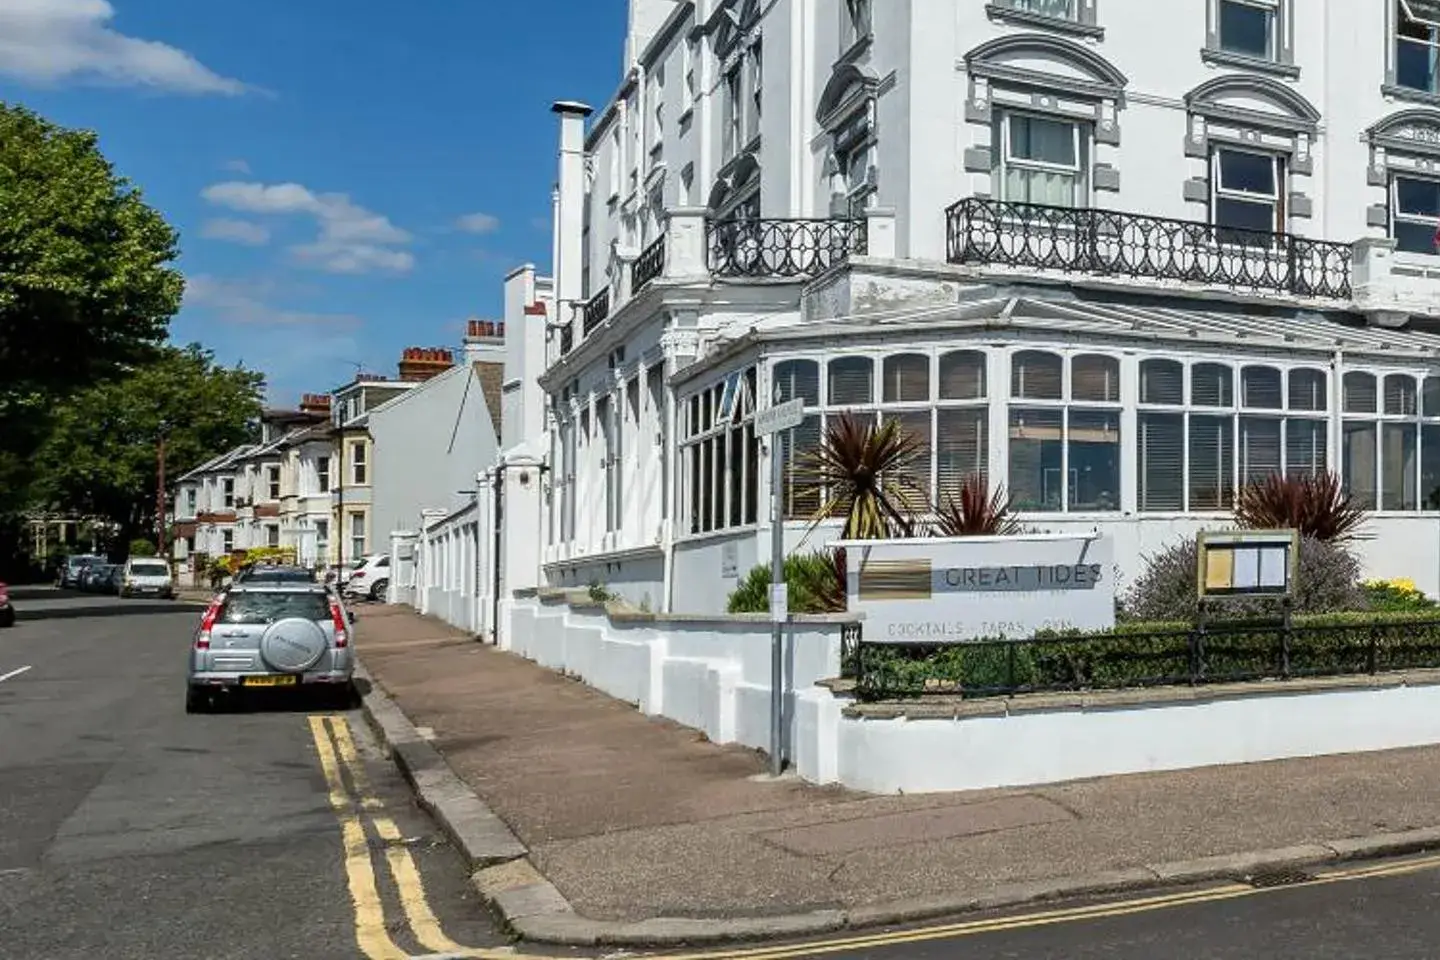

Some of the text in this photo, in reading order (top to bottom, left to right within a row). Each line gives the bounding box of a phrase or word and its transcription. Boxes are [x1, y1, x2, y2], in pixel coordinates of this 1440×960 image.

[945, 564, 1103, 586] GREAT TIDES
[888, 621, 963, 636] COCKTAILS
[981, 621, 1025, 633] TAPAS
